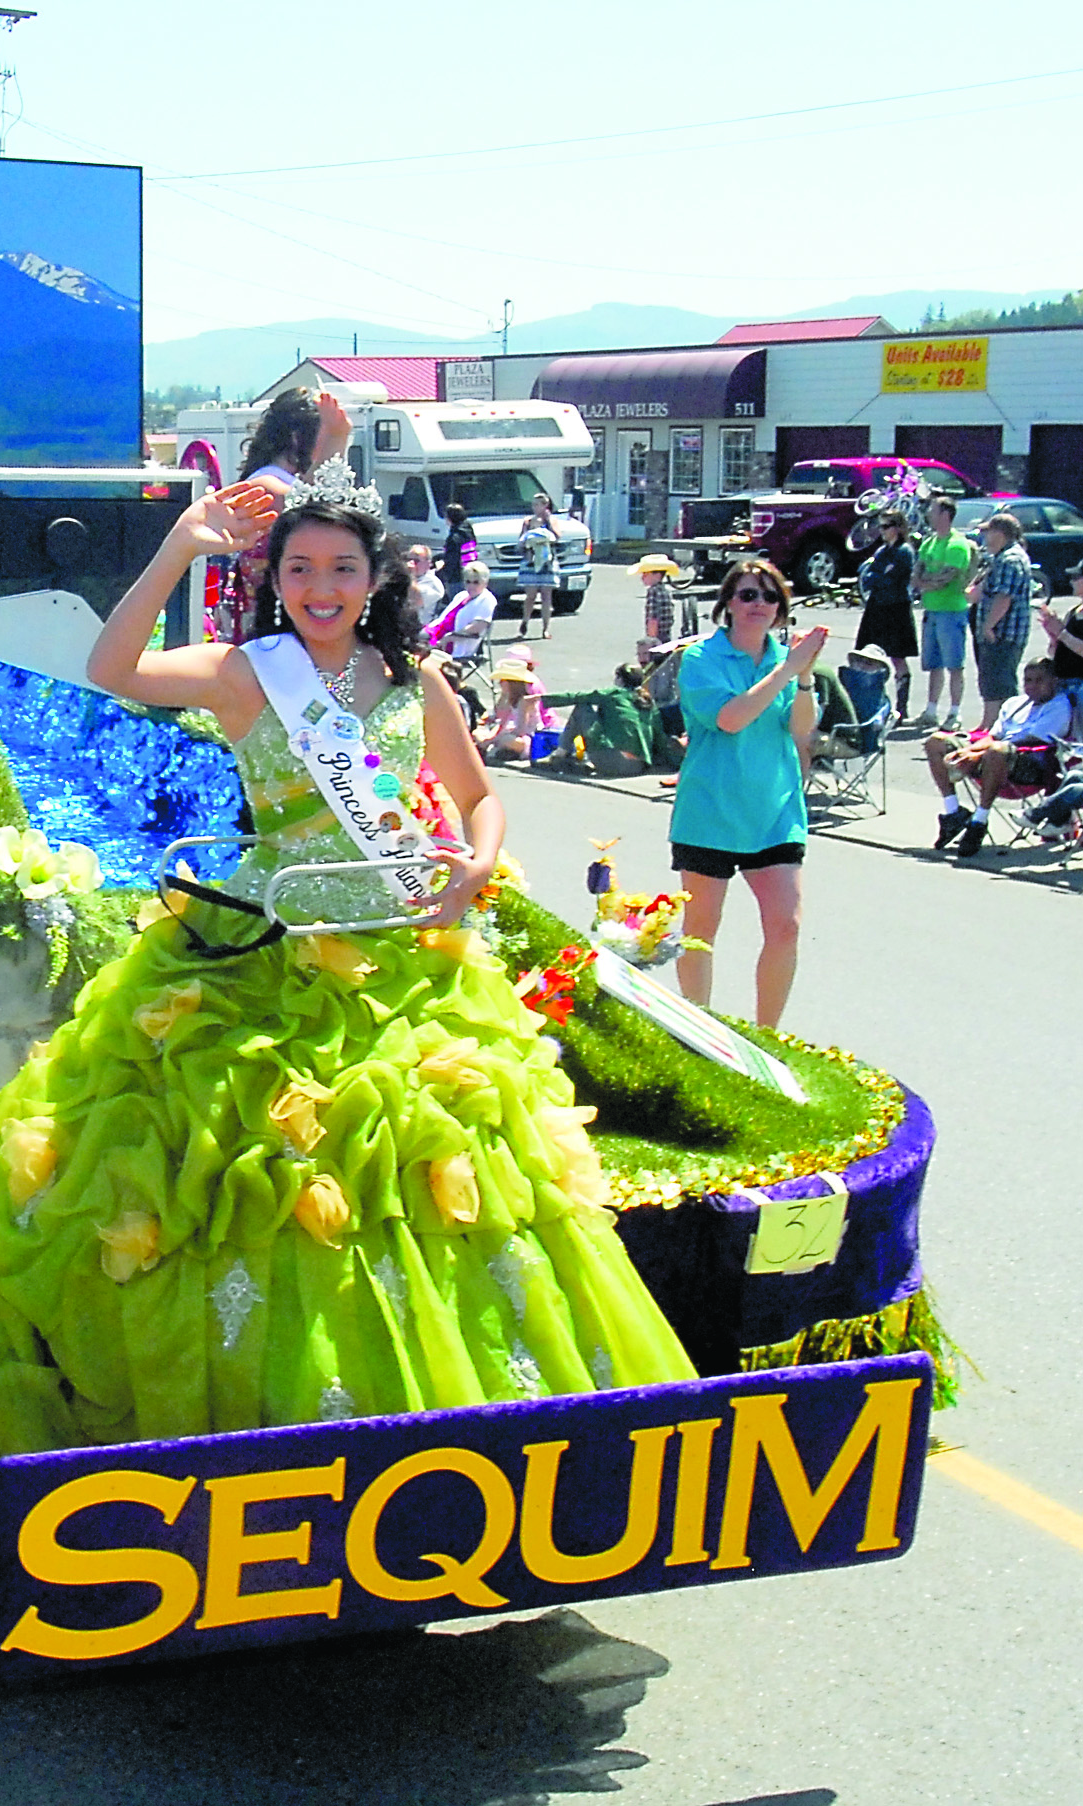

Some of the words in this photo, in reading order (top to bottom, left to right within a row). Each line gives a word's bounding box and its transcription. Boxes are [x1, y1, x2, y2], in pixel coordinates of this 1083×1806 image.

[921, 341, 982, 364] Available
[454, 363, 484, 376] PLAZA
[448, 375, 491, 389] JEWELERS
[616, 402, 668, 418] JEWELERS
[734, 402, 755, 416] 511
[317, 752, 380, 842] Princess
[760, 1200, 833, 1265] 32
[0, 1377, 921, 1661] SEQUIM
